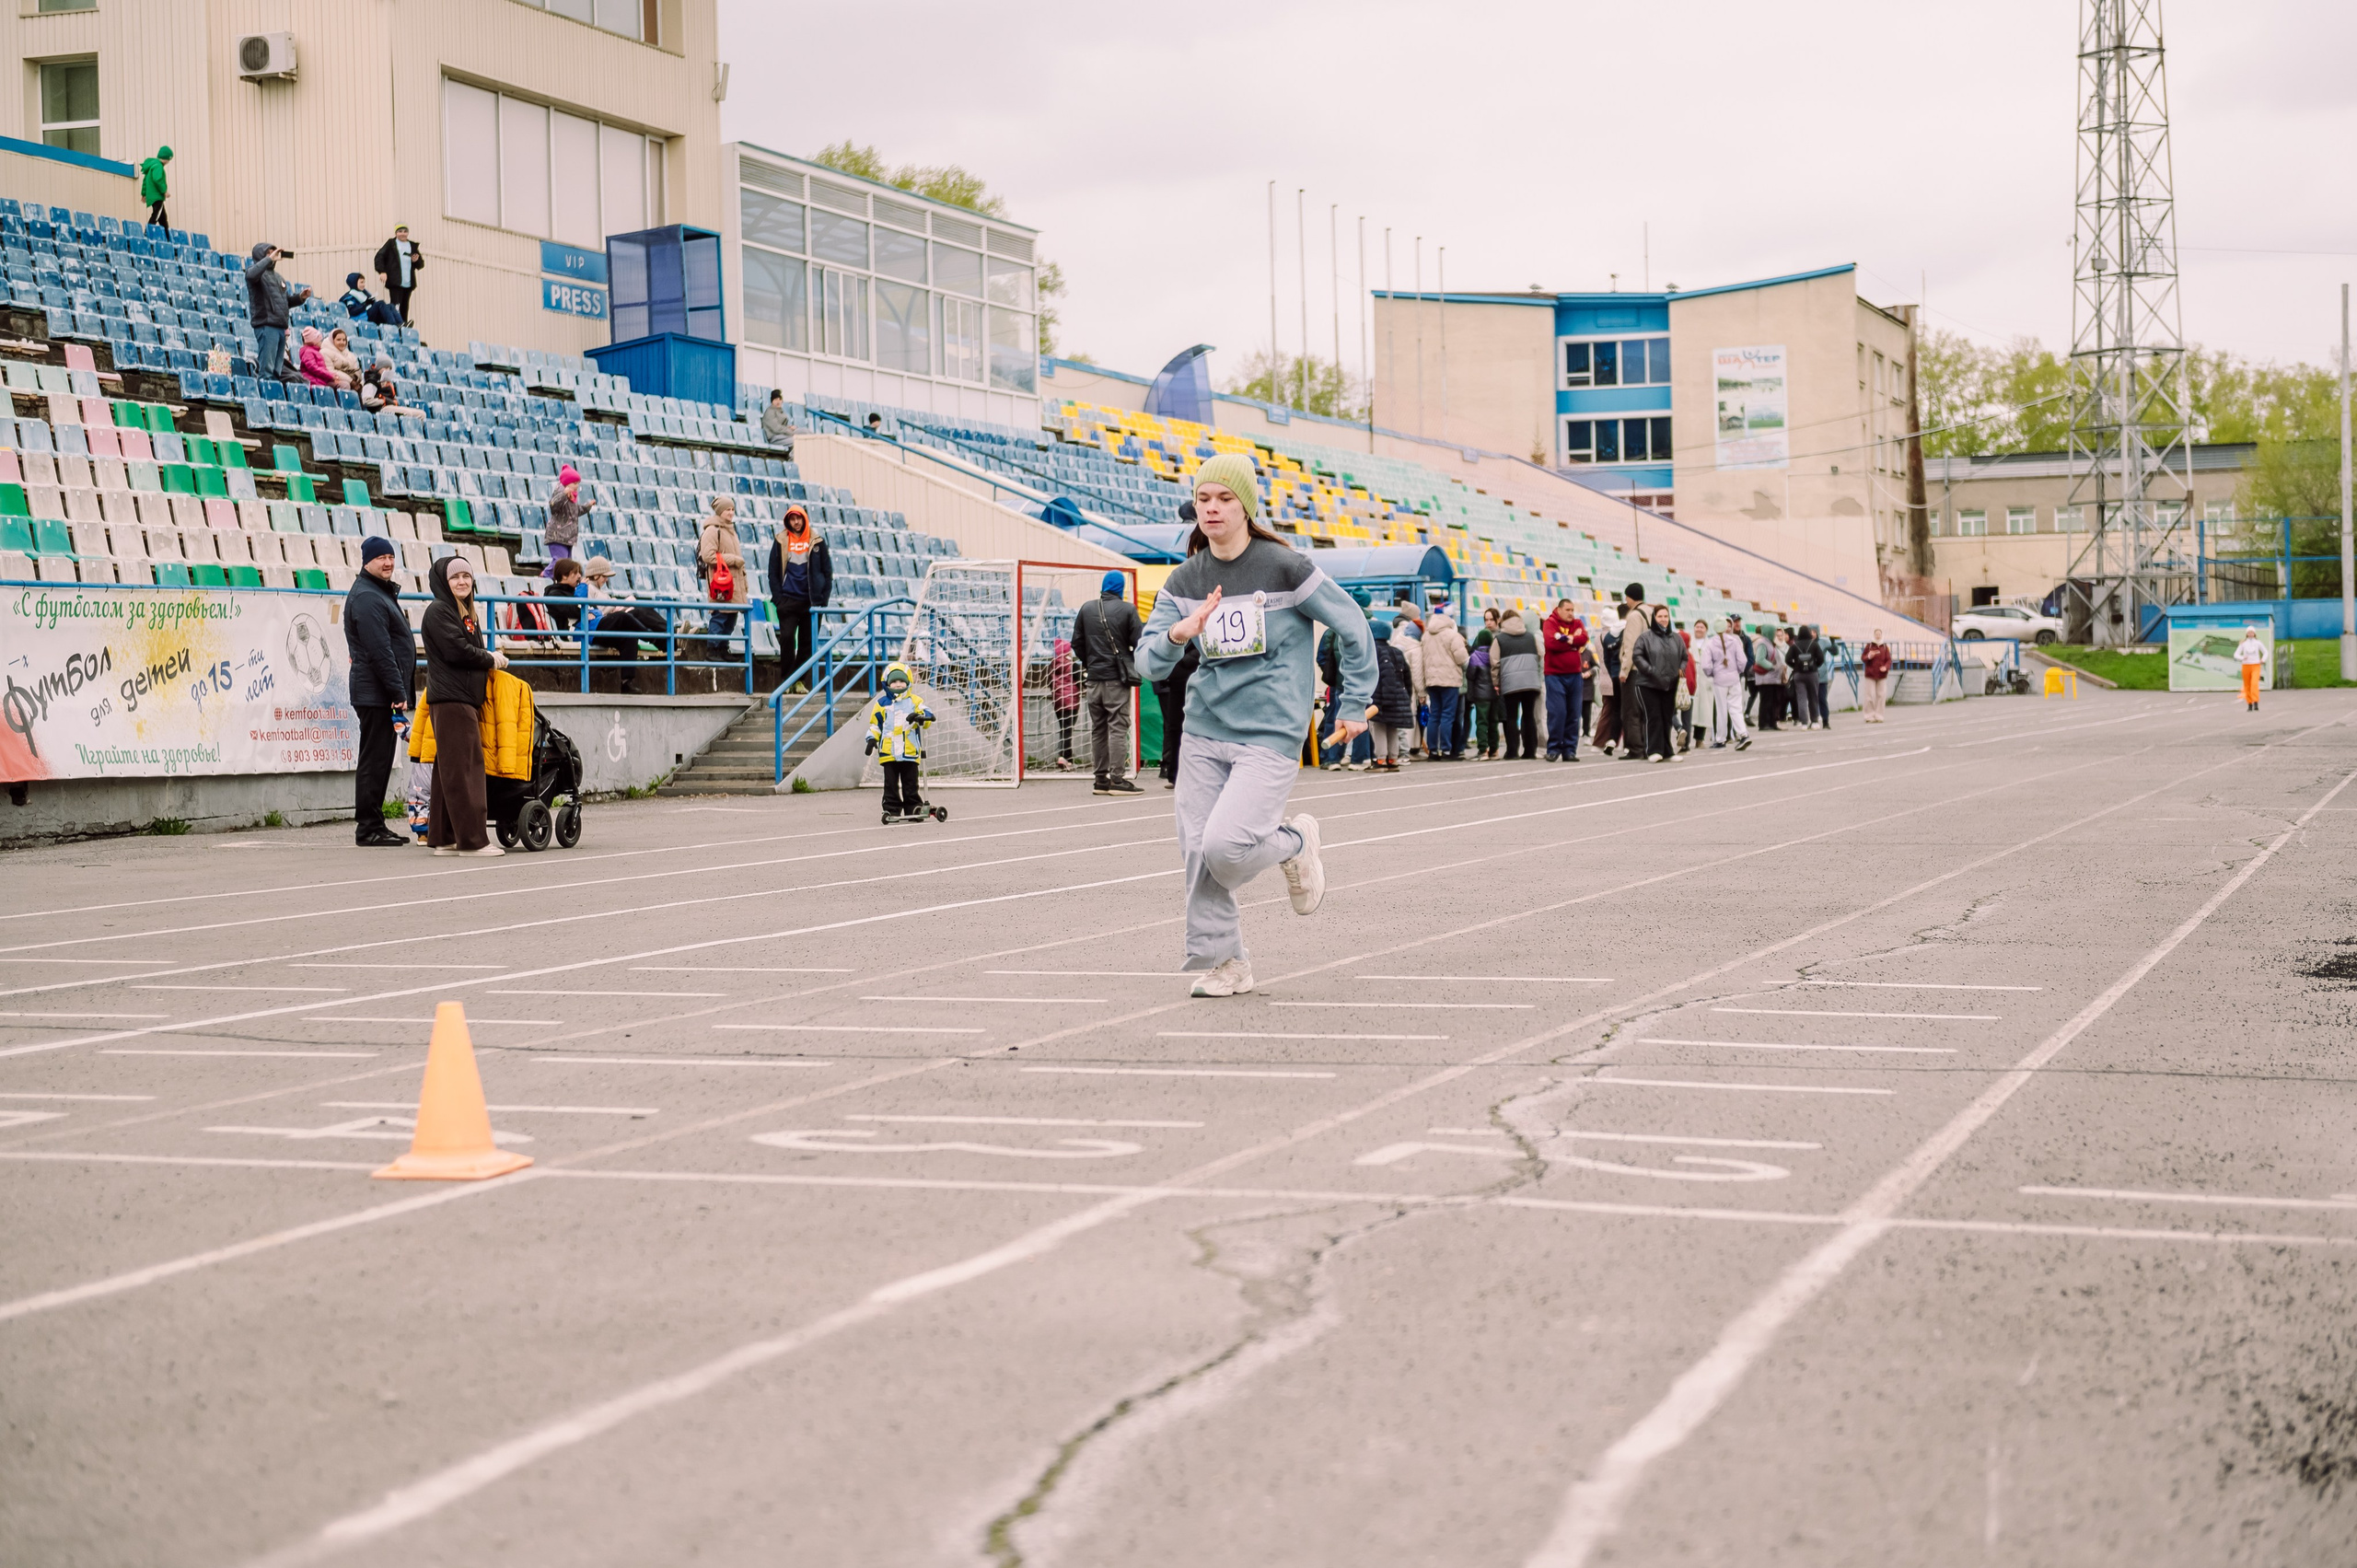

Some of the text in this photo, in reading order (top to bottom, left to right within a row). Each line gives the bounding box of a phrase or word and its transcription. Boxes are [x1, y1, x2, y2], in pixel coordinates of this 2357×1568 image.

[564, 253, 585, 270] VIP
[551, 284, 601, 316] PRESS
[35, 592, 124, 630] футболом
[126, 600, 146, 631] за
[148, 596, 242, 631] здоровьем!»
[1216, 610, 1246, 644] 19
[90, 647, 192, 727] для детей
[191, 679, 209, 714] до
[245, 664, 275, 703] лет
[259, 726, 350, 743] kemfootball@mail.ru
[75, 741, 222, 774] Играйте на здоровье!
[287, 750, 292, 762] 8
[294, 749, 311, 763] 903
[312, 748, 331, 762] 993
[341, 749, 352, 761] 50
